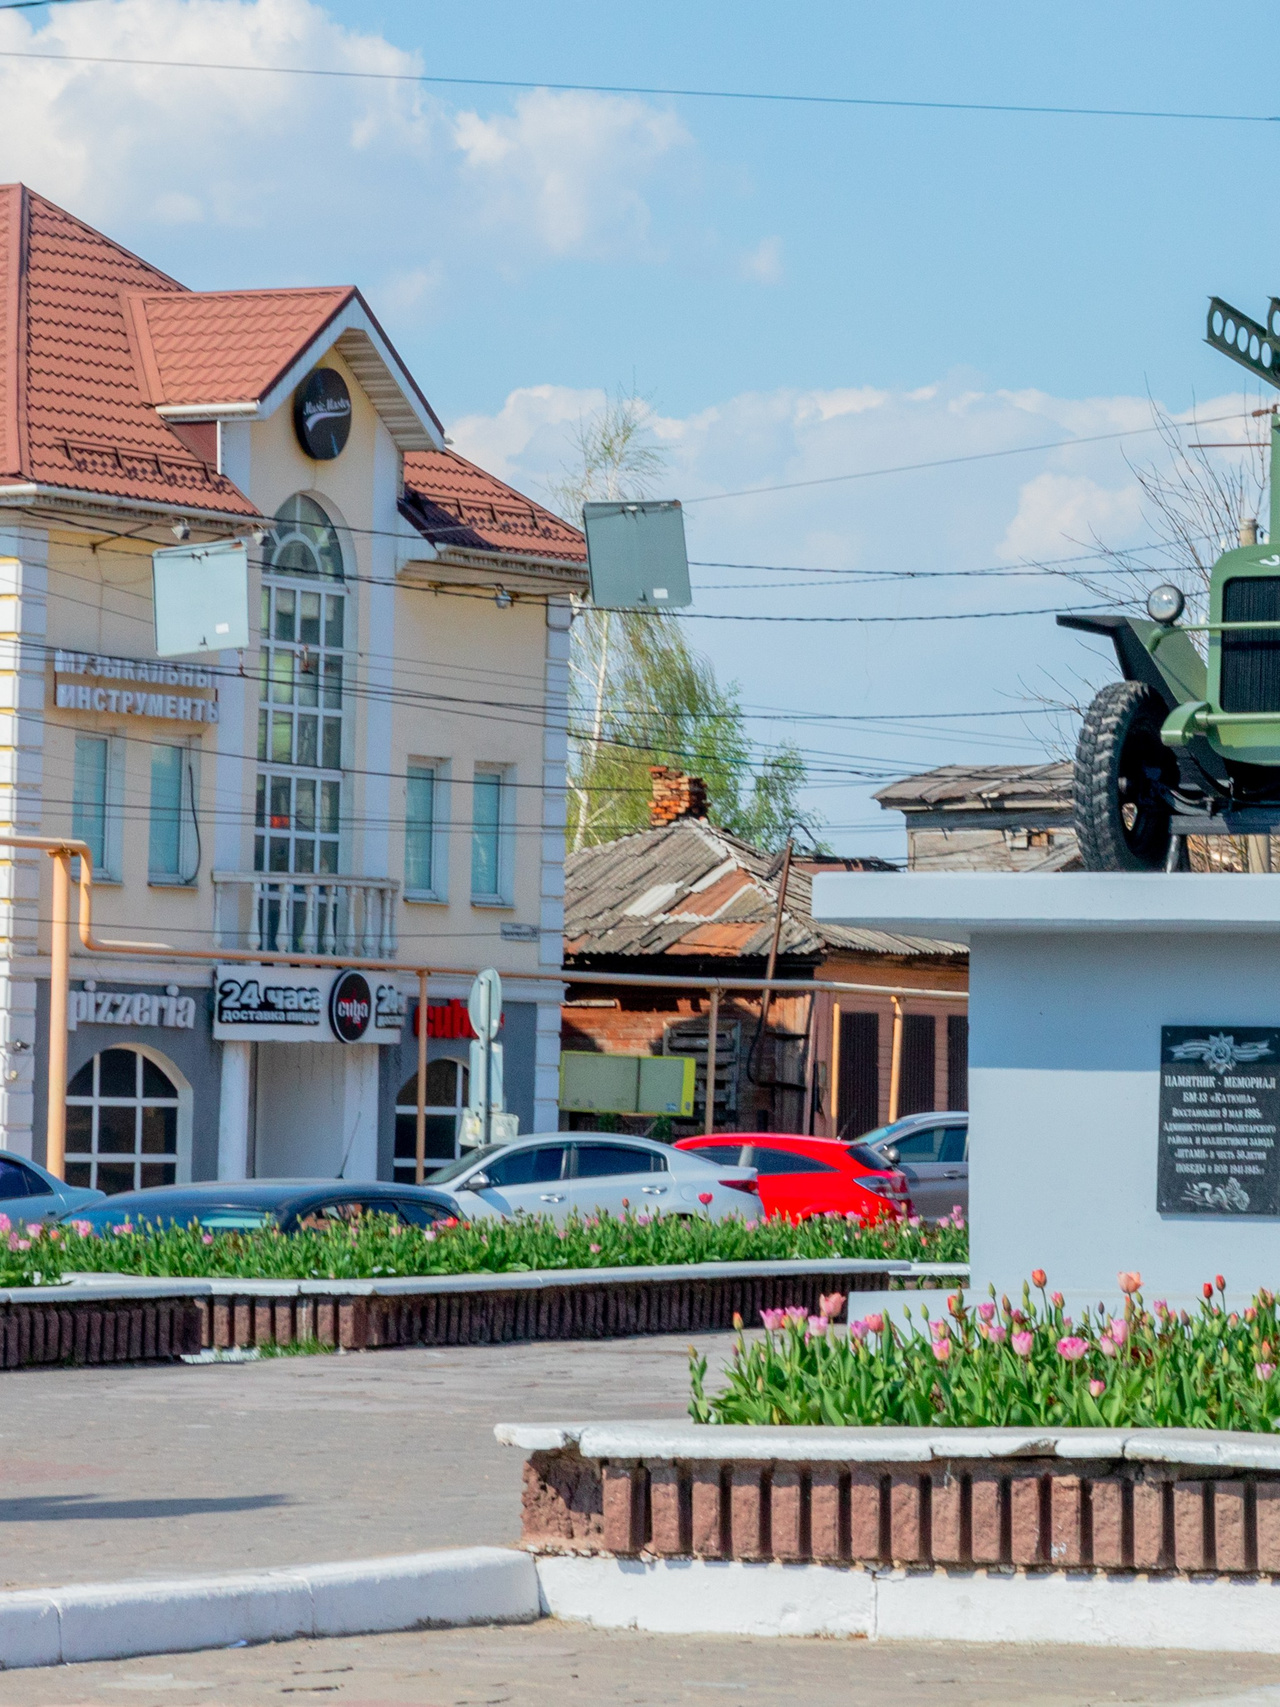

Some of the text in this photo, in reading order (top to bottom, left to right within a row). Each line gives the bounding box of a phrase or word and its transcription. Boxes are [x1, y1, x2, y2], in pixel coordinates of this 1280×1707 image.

[68, 980, 197, 1032] pizzeria
[220, 979, 322, 1011] 24 часа
[221, 1009, 286, 1024] доставка
[1164, 1075, 1216, 1088] ПАМЯТНИК
[1223, 1076, 1276, 1089] МЕМОРИАЛ
